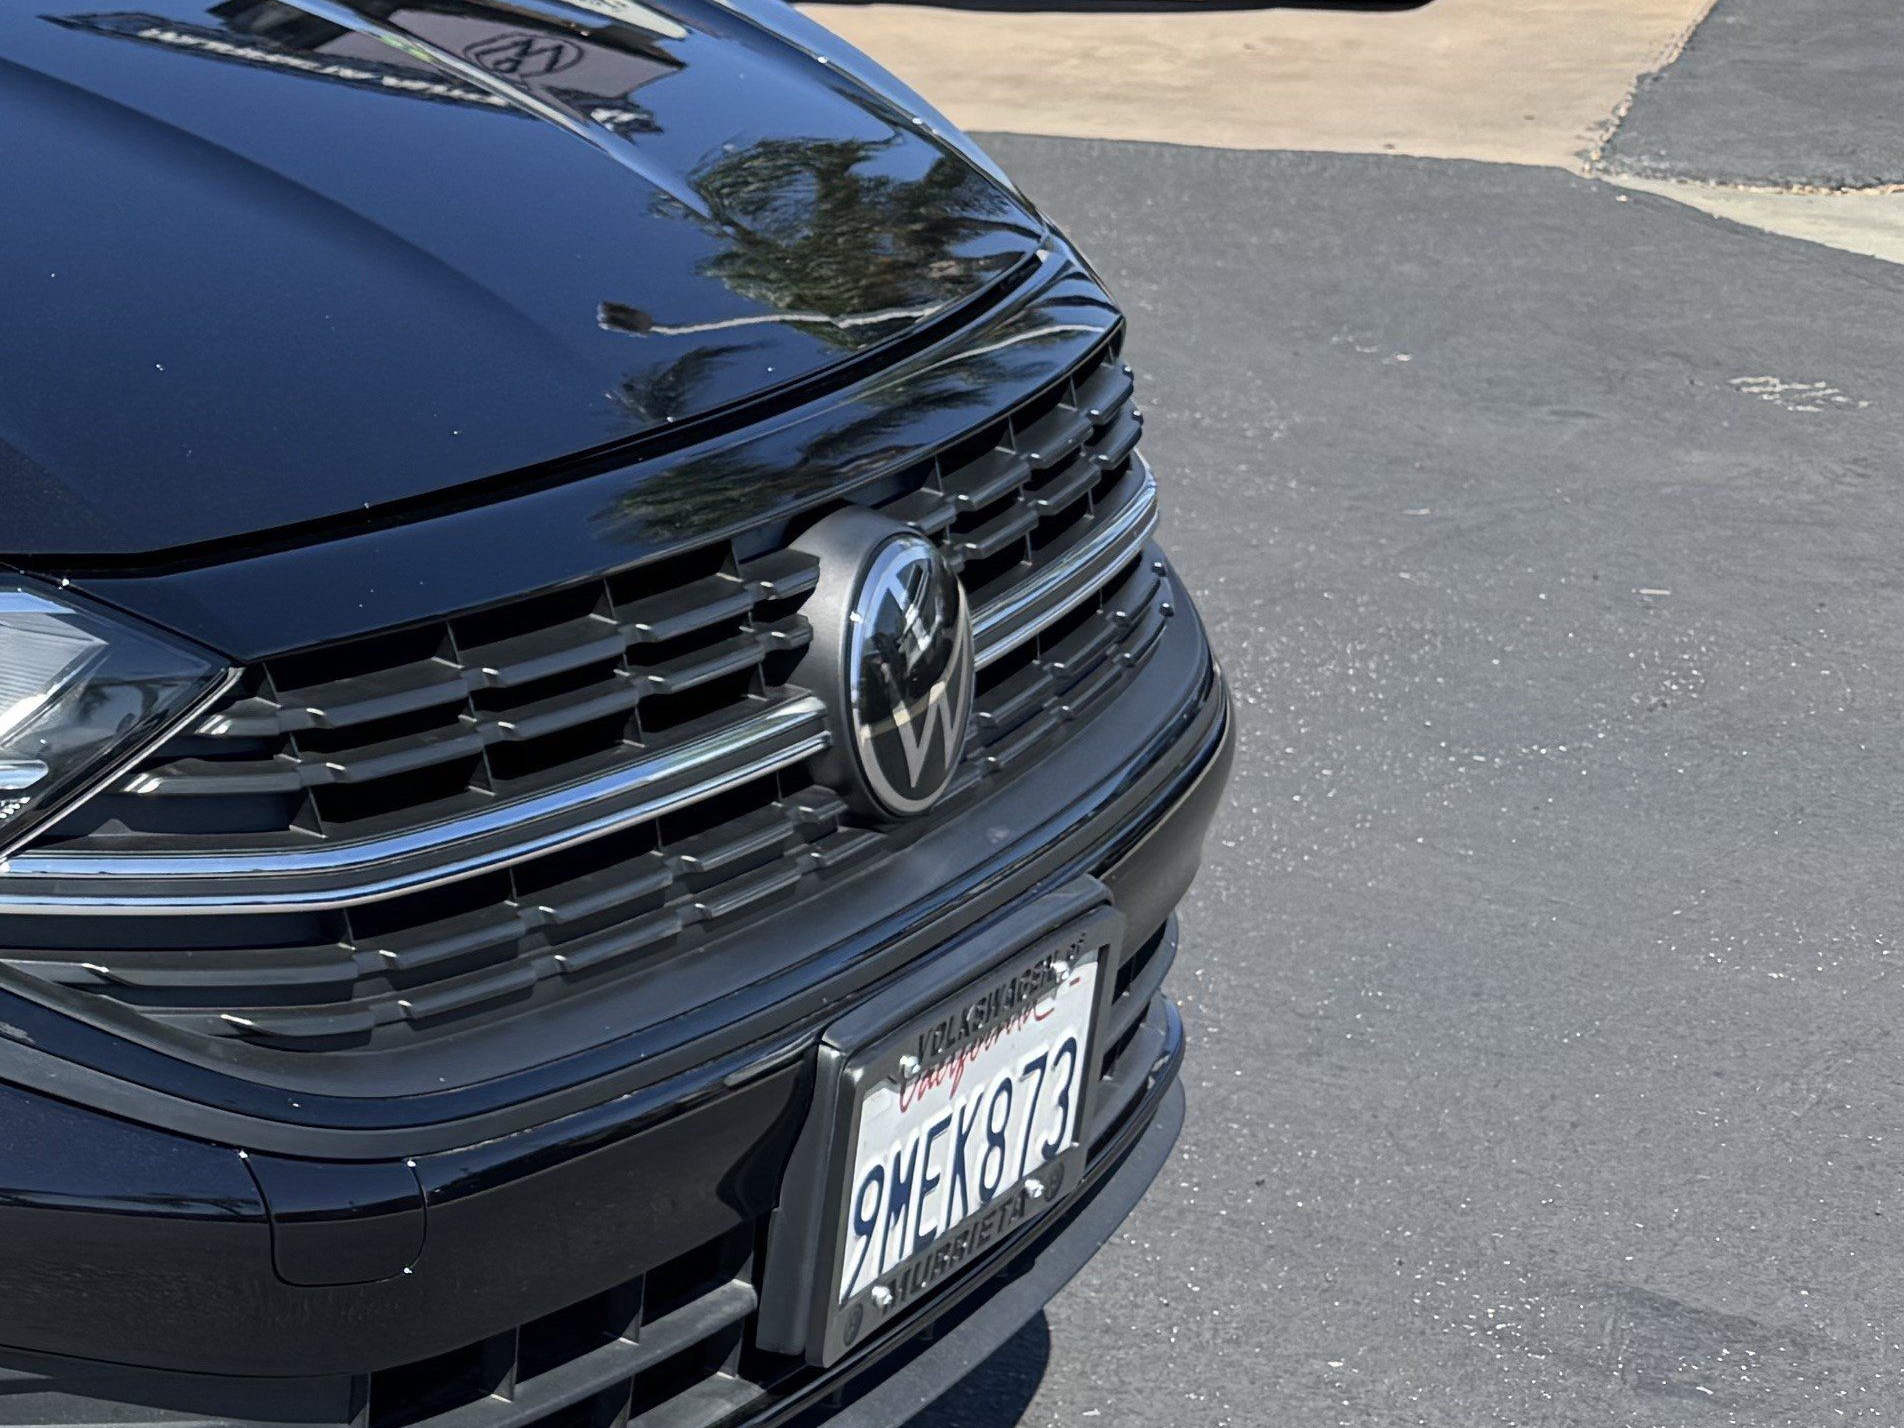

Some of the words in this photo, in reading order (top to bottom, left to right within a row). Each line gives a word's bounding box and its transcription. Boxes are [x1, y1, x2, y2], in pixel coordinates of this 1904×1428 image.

[916, 946, 1068, 1064] VOLKSWAGEN
[838, 1035, 1078, 1306] 9MEK873
[884, 1194, 1030, 1314] MURRIETA
